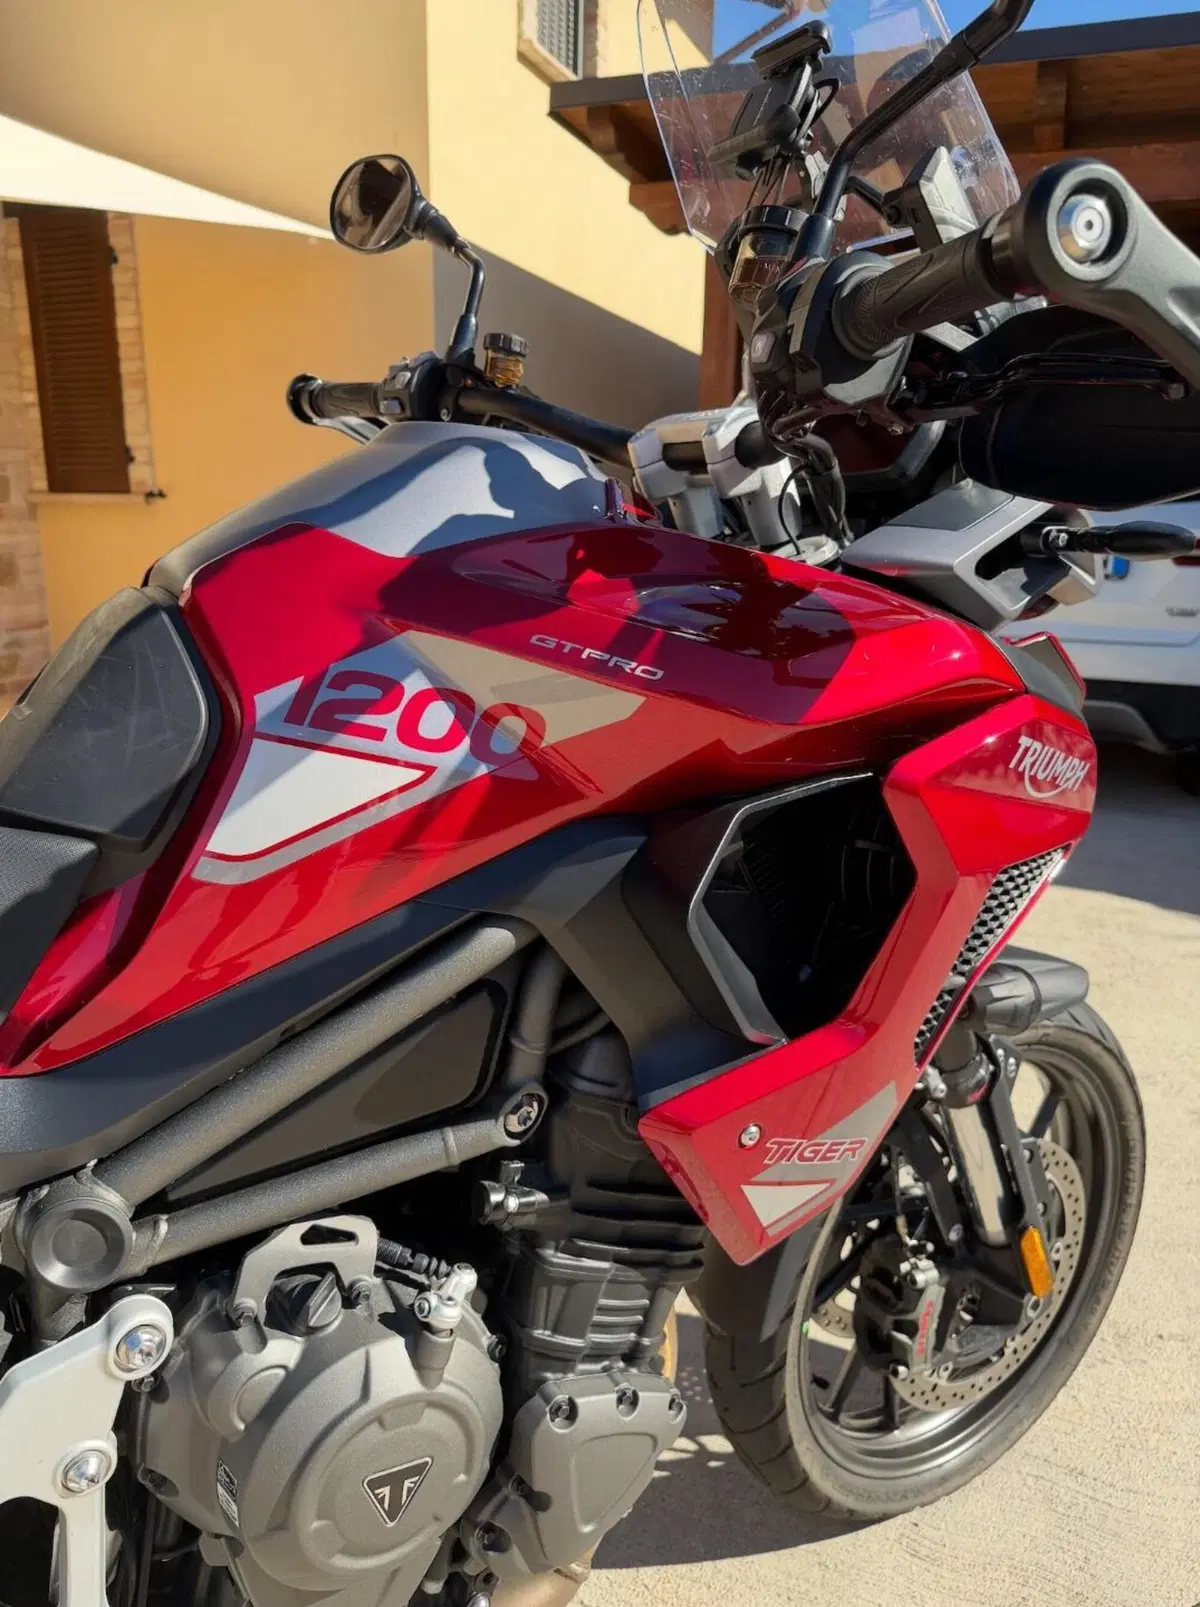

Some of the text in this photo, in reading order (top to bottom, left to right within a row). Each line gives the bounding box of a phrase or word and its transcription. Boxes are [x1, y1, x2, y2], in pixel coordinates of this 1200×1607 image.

[284, 668, 547, 767] 1200
[1009, 735, 1090, 798] TRIUMPH
[763, 1137, 868, 1164] TIGER
